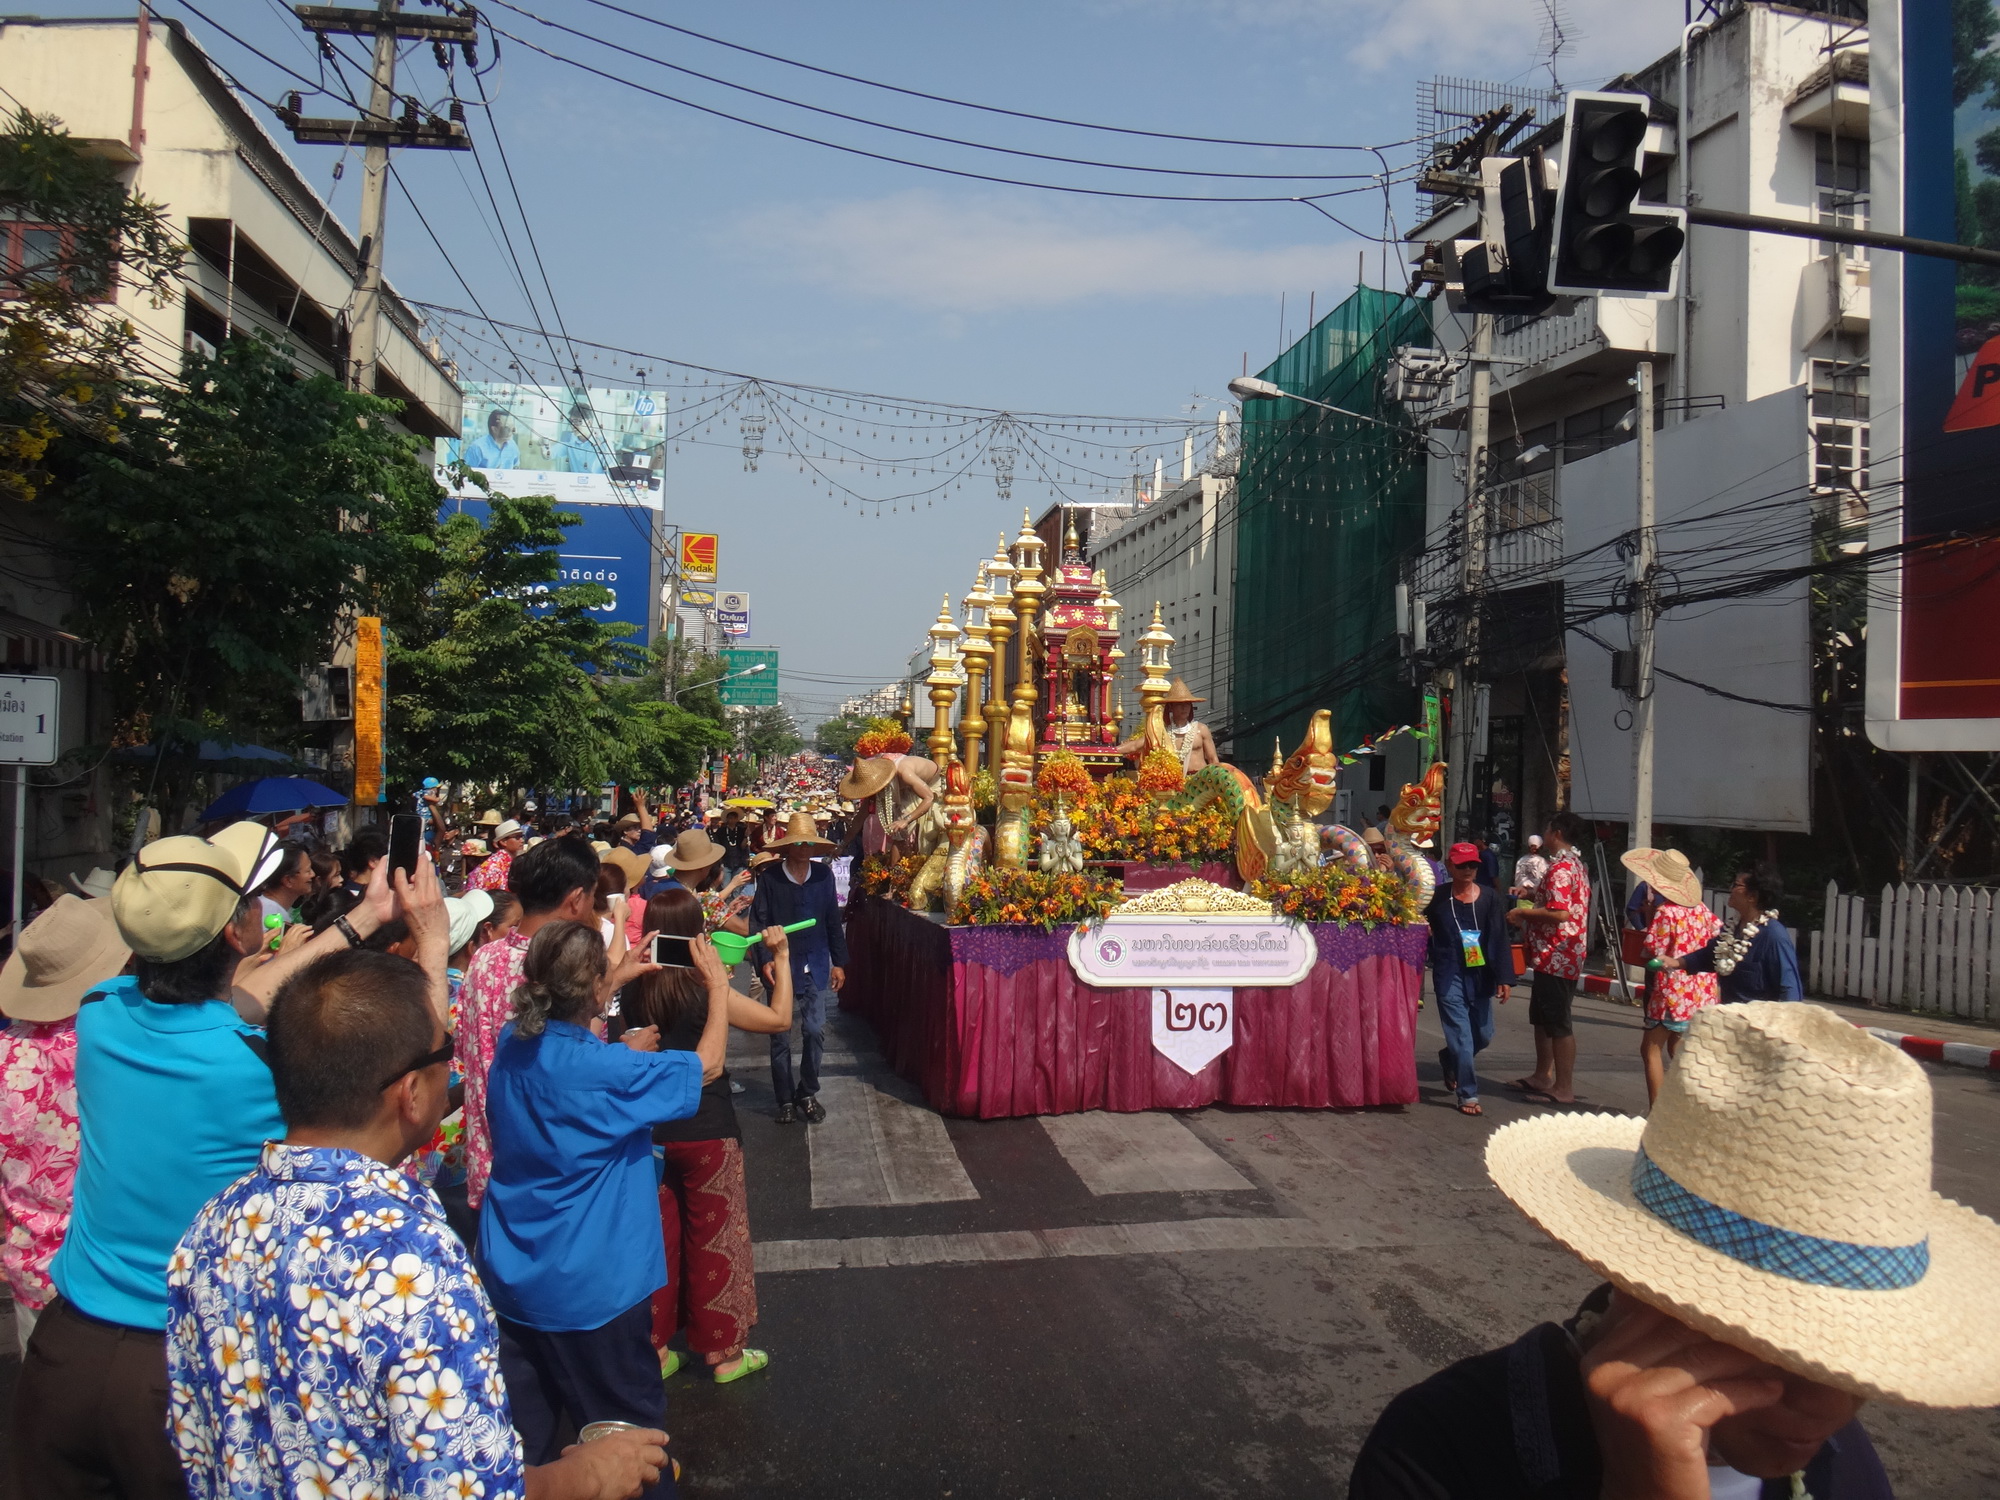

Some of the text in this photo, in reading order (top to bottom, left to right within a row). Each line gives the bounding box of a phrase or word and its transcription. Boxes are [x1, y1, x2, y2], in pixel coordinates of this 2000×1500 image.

[636, 398, 655, 416] hp
[683, 563, 714, 573] Kodak
[727, 597, 738, 605] ICI
[719, 613, 746, 622] Dulux
[36, 714, 46, 734] 1
[1160, 988, 1228, 1033] ๒๓
